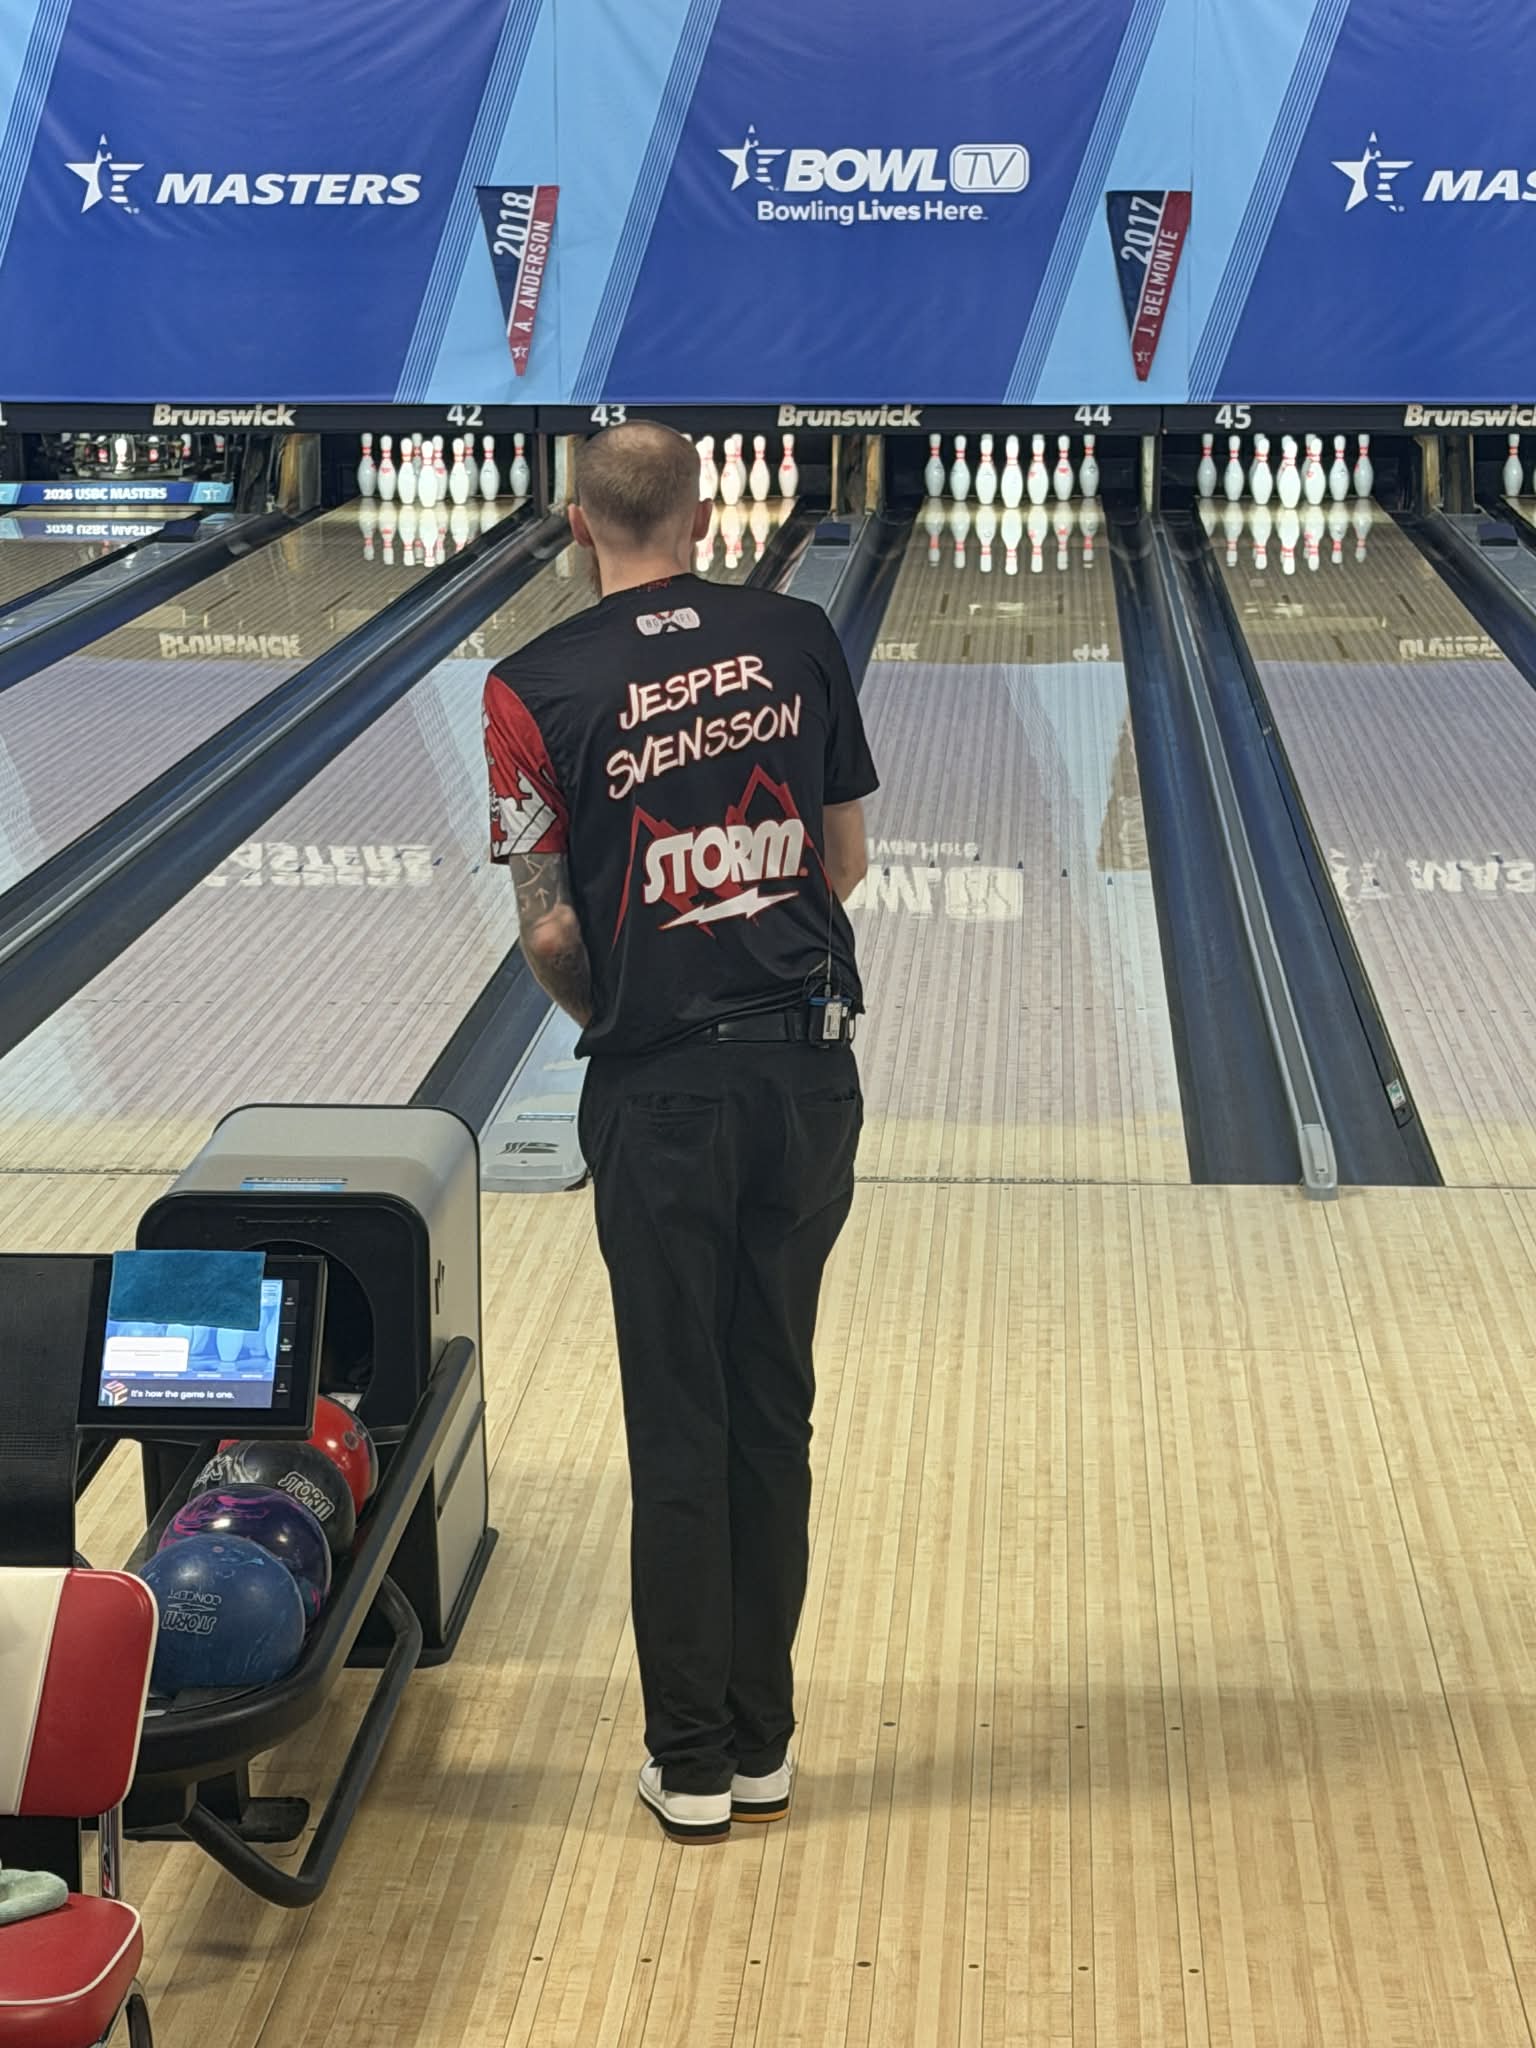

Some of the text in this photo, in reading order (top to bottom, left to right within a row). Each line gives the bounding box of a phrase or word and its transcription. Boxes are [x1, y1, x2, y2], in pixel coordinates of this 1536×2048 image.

[783, 148, 1019, 193] BOWL TV
[155, 172, 423, 206] MASTERS
[493, 191, 533, 259] 2018
[757, 200, 855, 226] Bowling
[858, 199, 921, 221] Lives
[1120, 196, 1163, 265] 2017
[514, 220, 552, 333] A. ANDERSON
[1138, 228, 1179, 338] J. BELMONTE
[153, 404, 296, 427] Brunswick
[446, 404, 484, 427] 42
[590, 404, 627, 427] 43
[777, 404, 923, 427] Brunswick
[1074, 405, 1112, 427] 44
[1215, 405, 1252, 429] 45
[1403, 404, 1536, 427] Brunswic
[43, 487, 167, 500] 2026 USBC MASTERS
[619, 654, 773, 731] JESPER
[606, 694, 802, 800] SVENSSON
[643, 818, 806, 905] STORM
[130, 1389, 235, 1401] It's how the game is one.
[276, 1471, 336, 1523] STORM
[161, 1610, 217, 1635] STORM
